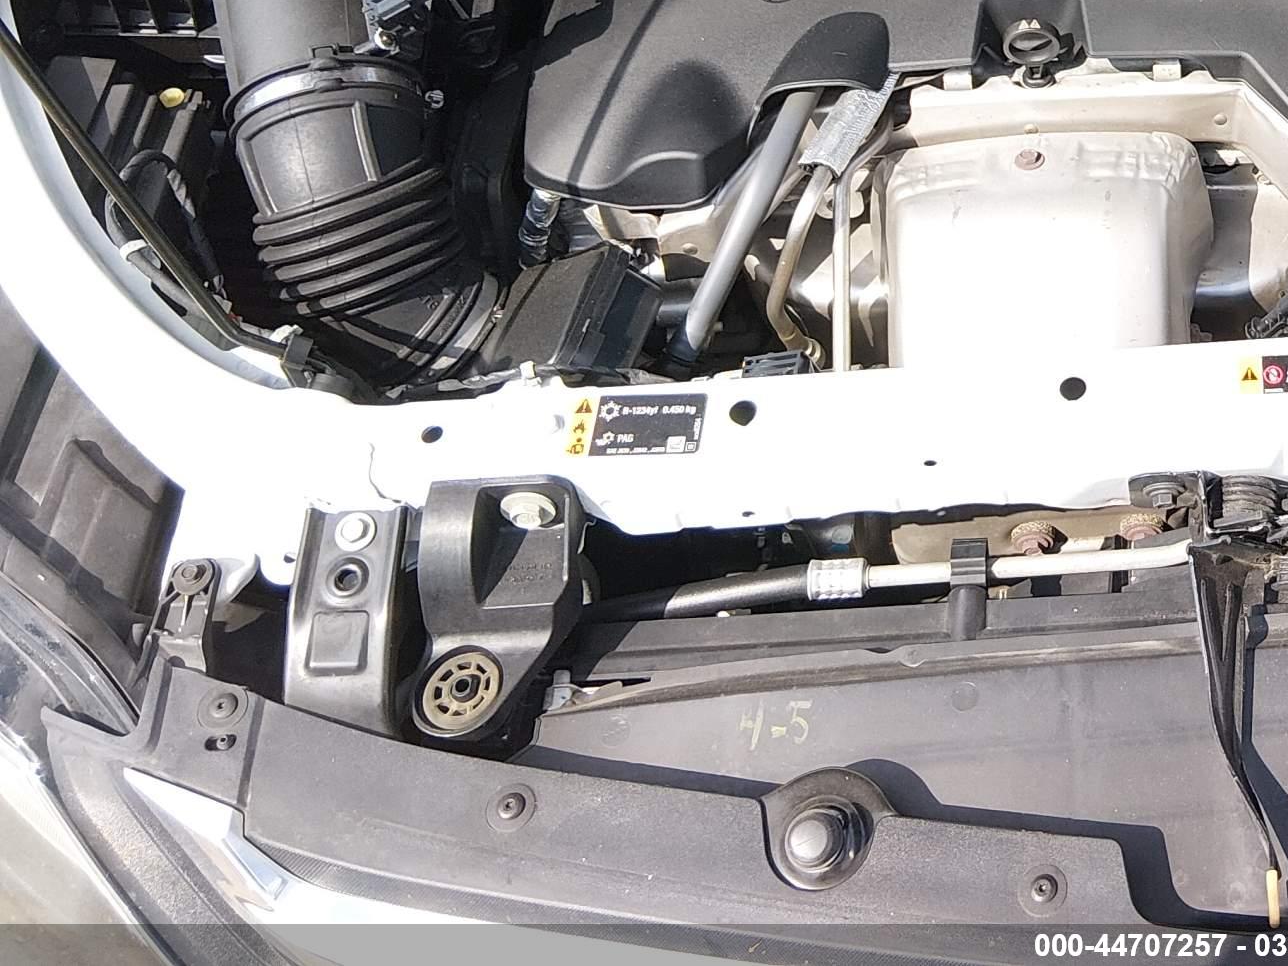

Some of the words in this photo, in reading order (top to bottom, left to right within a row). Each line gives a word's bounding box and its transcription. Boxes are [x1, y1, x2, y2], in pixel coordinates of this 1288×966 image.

[622, 405, 659, 417] R-1234yf
[685, 405, 697, 416] kg
[616, 433, 635, 444] PAG
